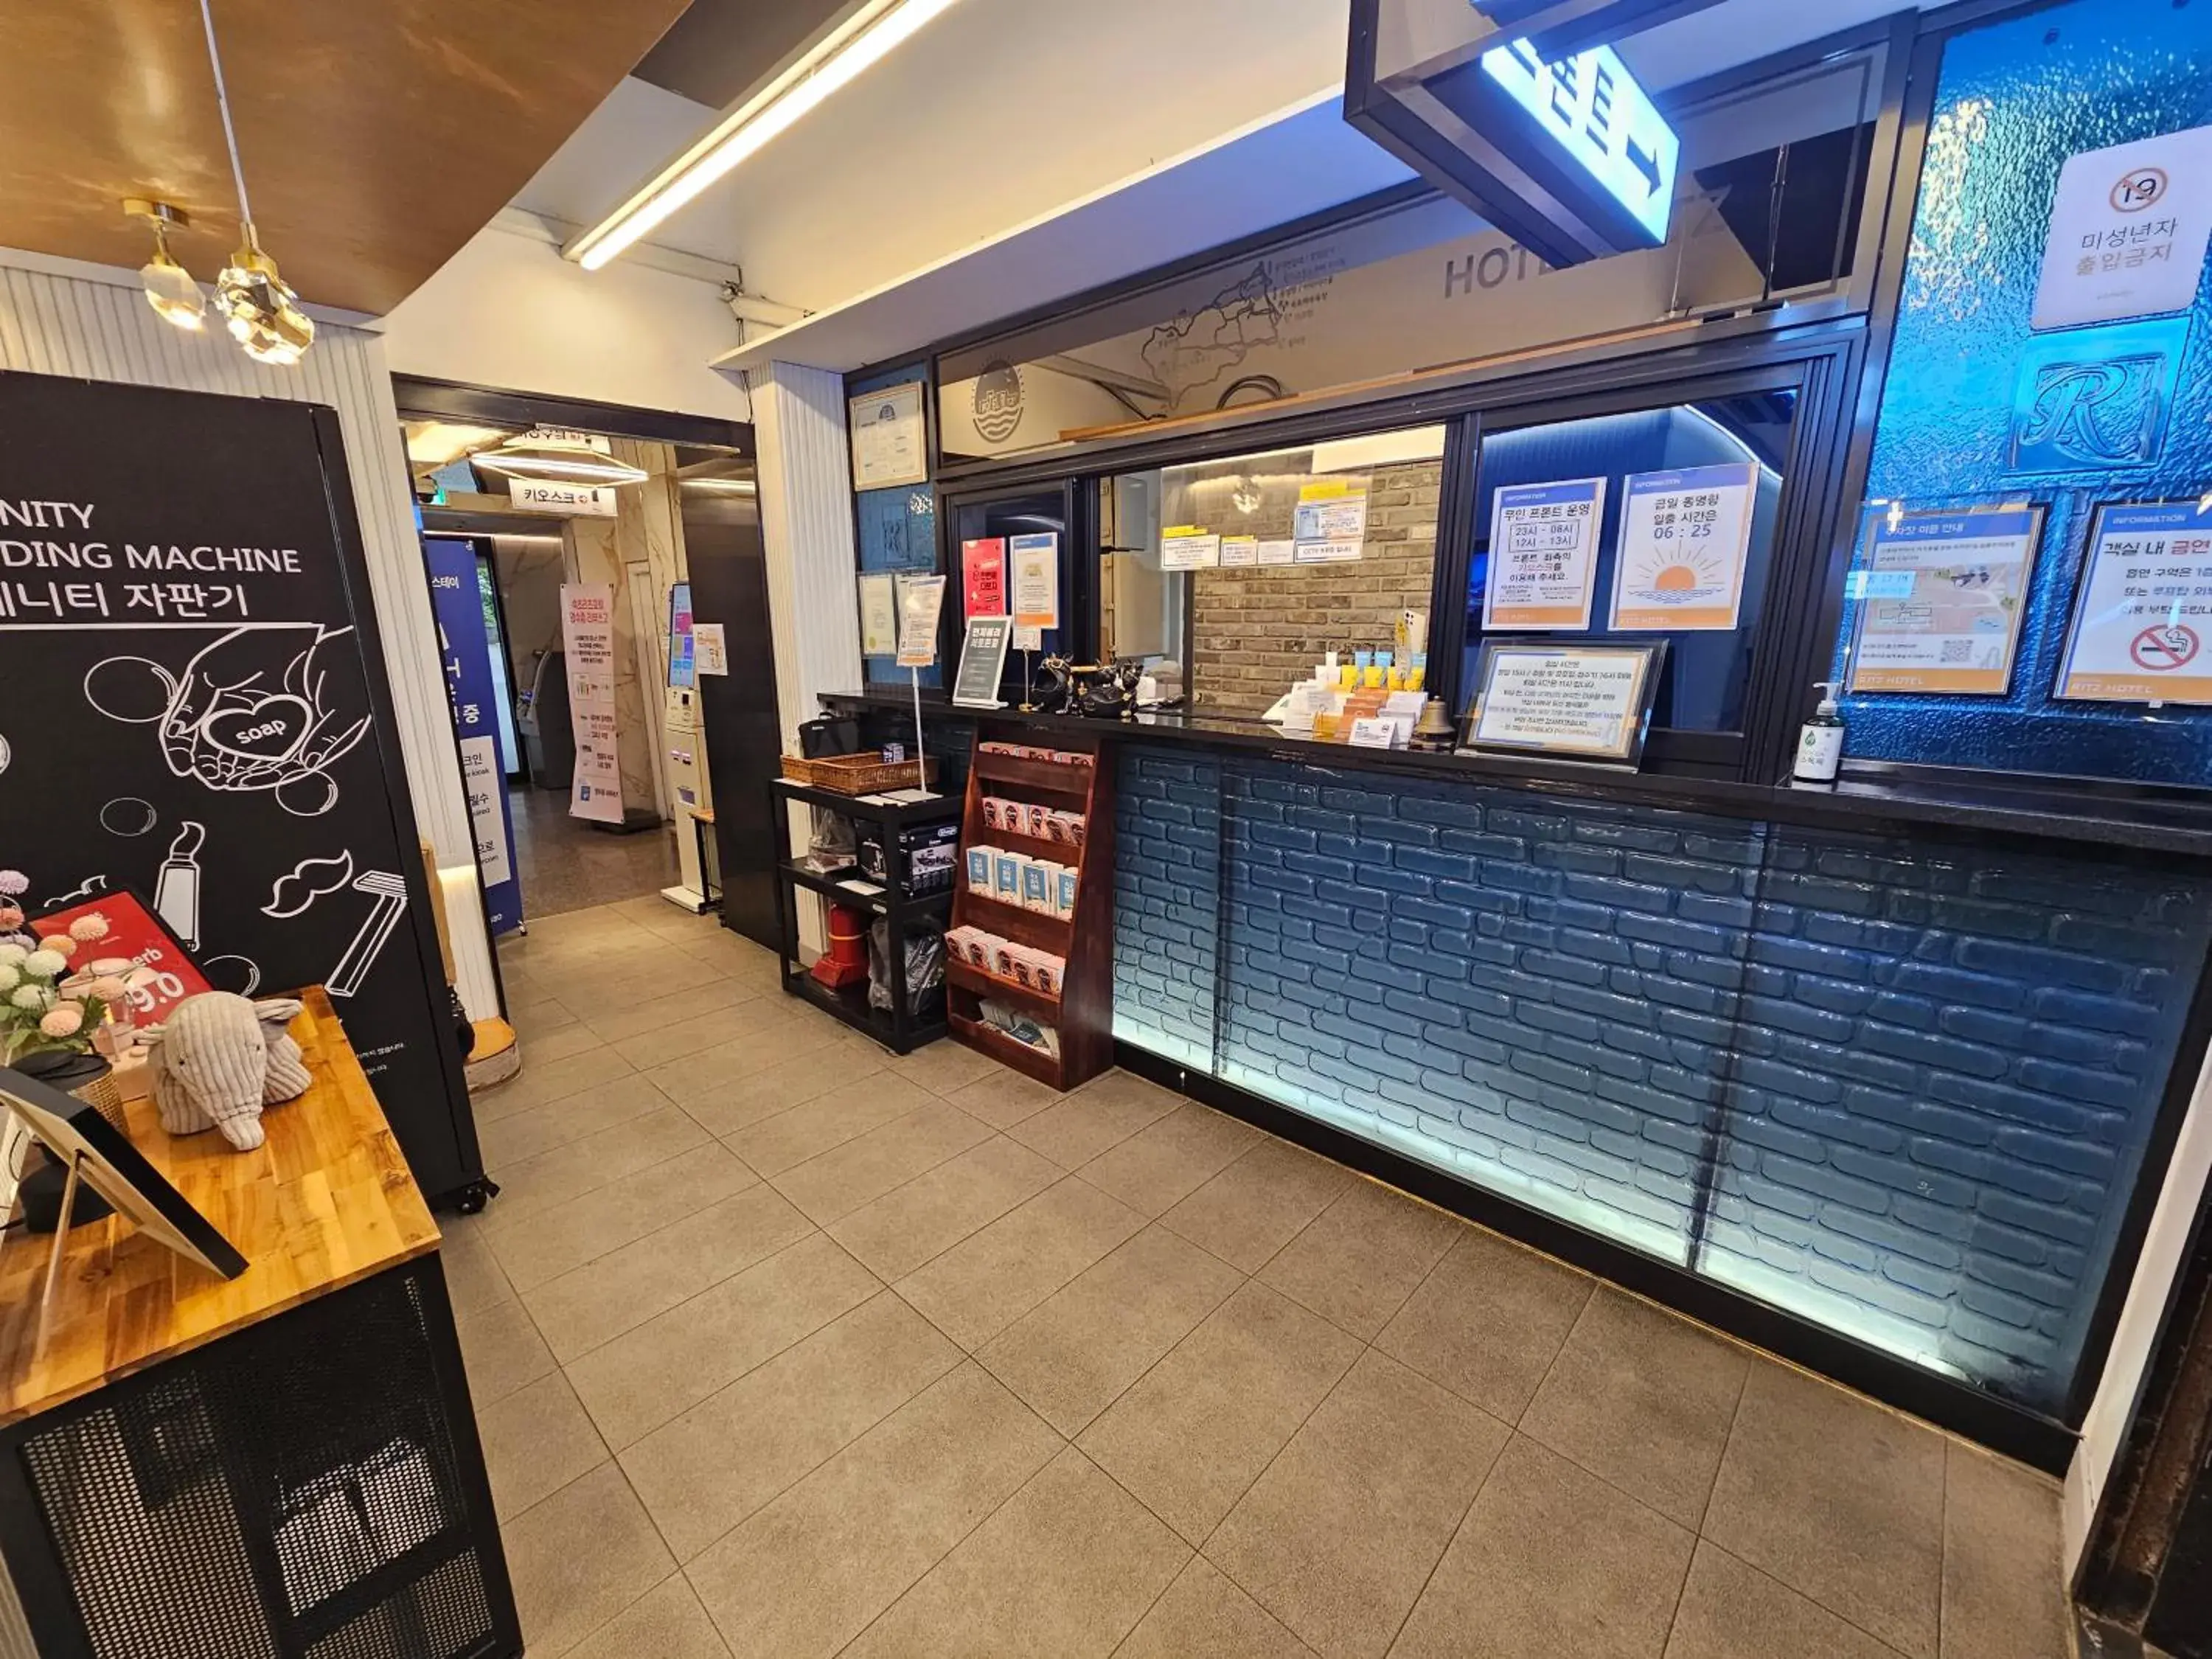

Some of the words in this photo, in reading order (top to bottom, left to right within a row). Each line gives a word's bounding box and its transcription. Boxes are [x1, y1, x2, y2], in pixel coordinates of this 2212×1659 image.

[2122, 178, 2157, 203] 19
[2081, 217, 2178, 250] 미성년자
[2076, 243, 2172, 276] 출입금지
[524, 489, 574, 504] 키오스크
[0, 499, 95, 529] NITY
[1529, 506, 1562, 518] 프론트
[1681, 509, 1717, 523] 시간은
[2112, 514, 2187, 525] INFORMATION
[1515, 524, 1537, 536] 23시
[1654, 526, 1674, 539] 06
[1691, 523, 1711, 537] 25
[1516, 538, 1536, 547] 12시
[1550, 535, 1571, 546] 13시
[2104, 542, 2140, 557] 객실
[2145, 540, 2166, 554] 내
[2171, 539, 2211, 554] 금연
[0, 540, 113, 569] DING
[125, 544, 302, 574] MACHINE
[431, 576, 459, 589] 스테이
[122, 582, 248, 617] 자판기
[2179, 605, 2212, 614] 드립니
[235, 717, 288, 745] soap
